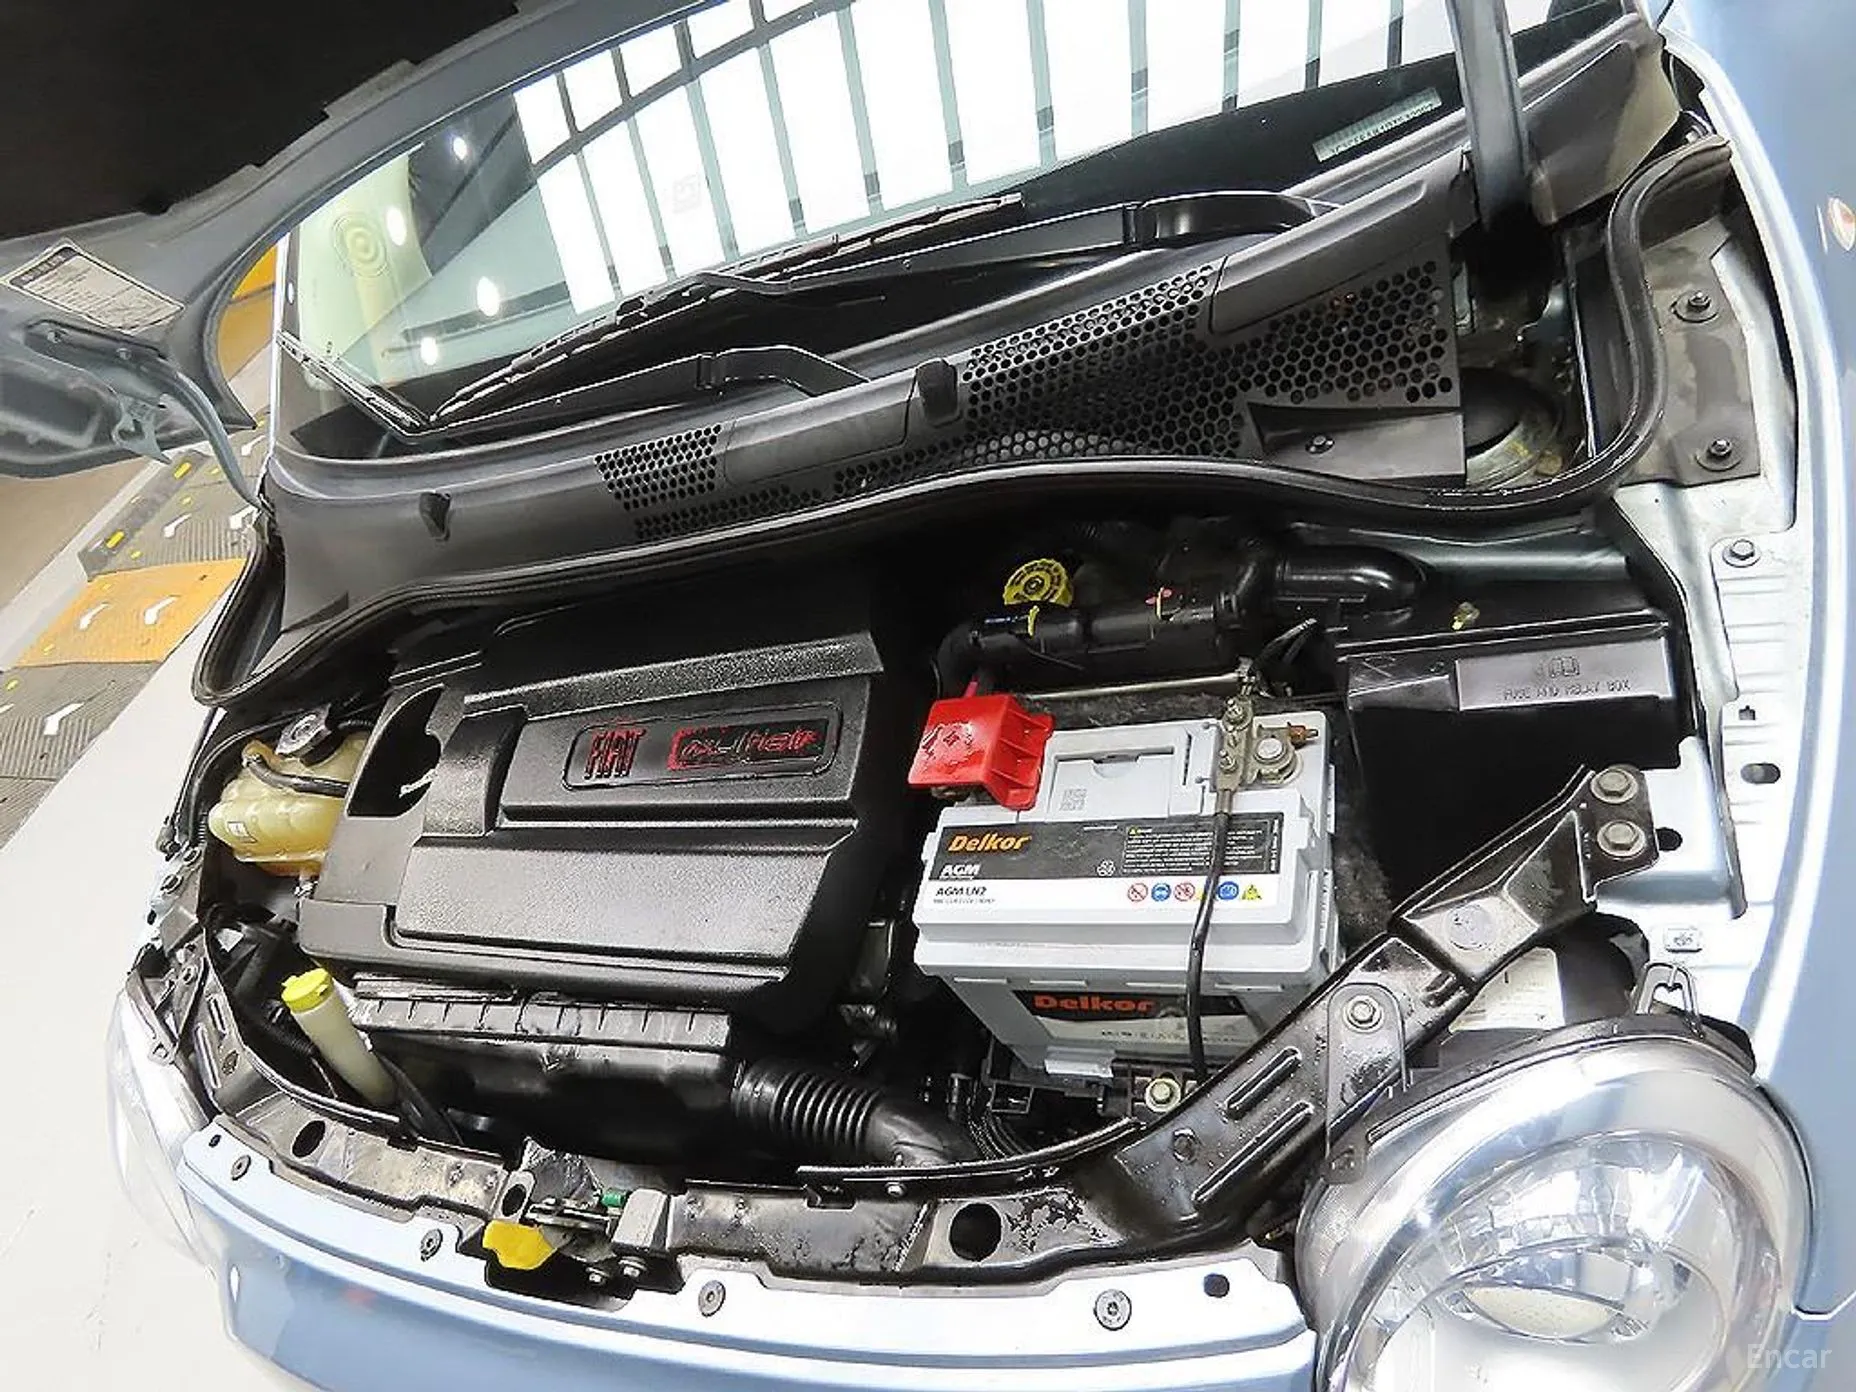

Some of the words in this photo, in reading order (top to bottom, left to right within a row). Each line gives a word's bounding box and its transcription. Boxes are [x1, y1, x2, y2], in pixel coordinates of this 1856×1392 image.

[583, 729, 647, 780] FIAT
[947, 831, 1032, 852] Delkor
[939, 863, 981, 877] AGM
[1033, 994, 1157, 1015] Delkor
